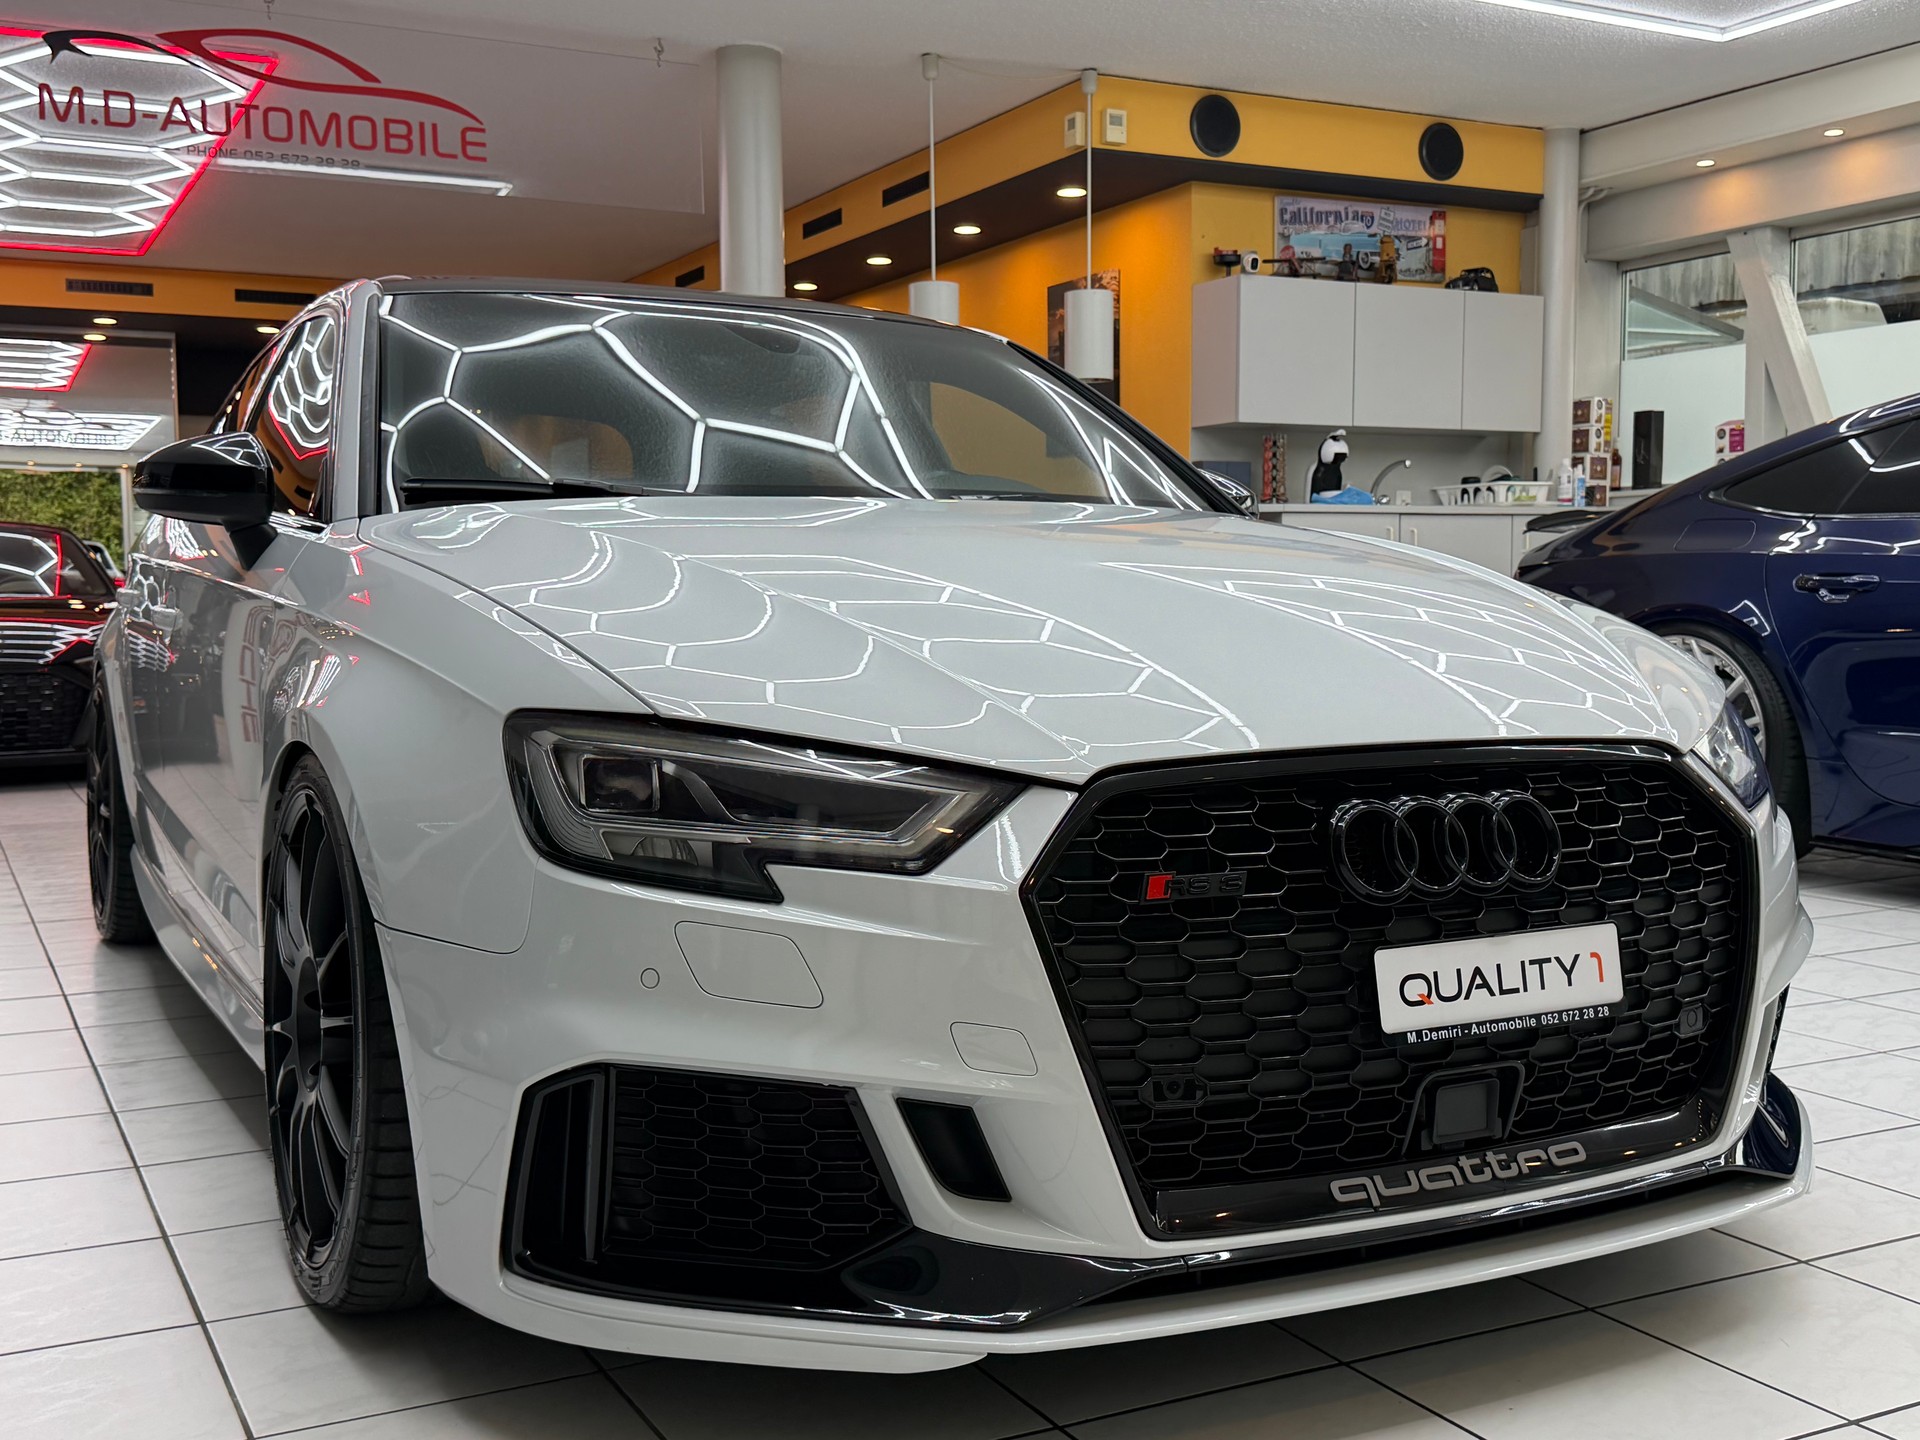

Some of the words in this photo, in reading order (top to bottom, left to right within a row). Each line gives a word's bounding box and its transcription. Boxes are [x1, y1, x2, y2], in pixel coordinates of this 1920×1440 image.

[37, 82, 489, 164] M.D-AUTOMOBILE
[187, 144, 238, 158] PHONE
[1279, 206, 1360, 227] California
[1164, 877, 1210, 897] RS
[1398, 953, 1581, 1008] QUALITY
[1589, 951, 1605, 983] 1
[1470, 1016, 1537, 1035] Automobile
[1541, 1013, 1560, 1026] 052
[1562, 1009, 1581, 1022] 672
[1583, 1007, 1596, 1020] 28
[1597, 1005, 1610, 1018] 28
[1329, 1140, 1588, 1208] quattro
